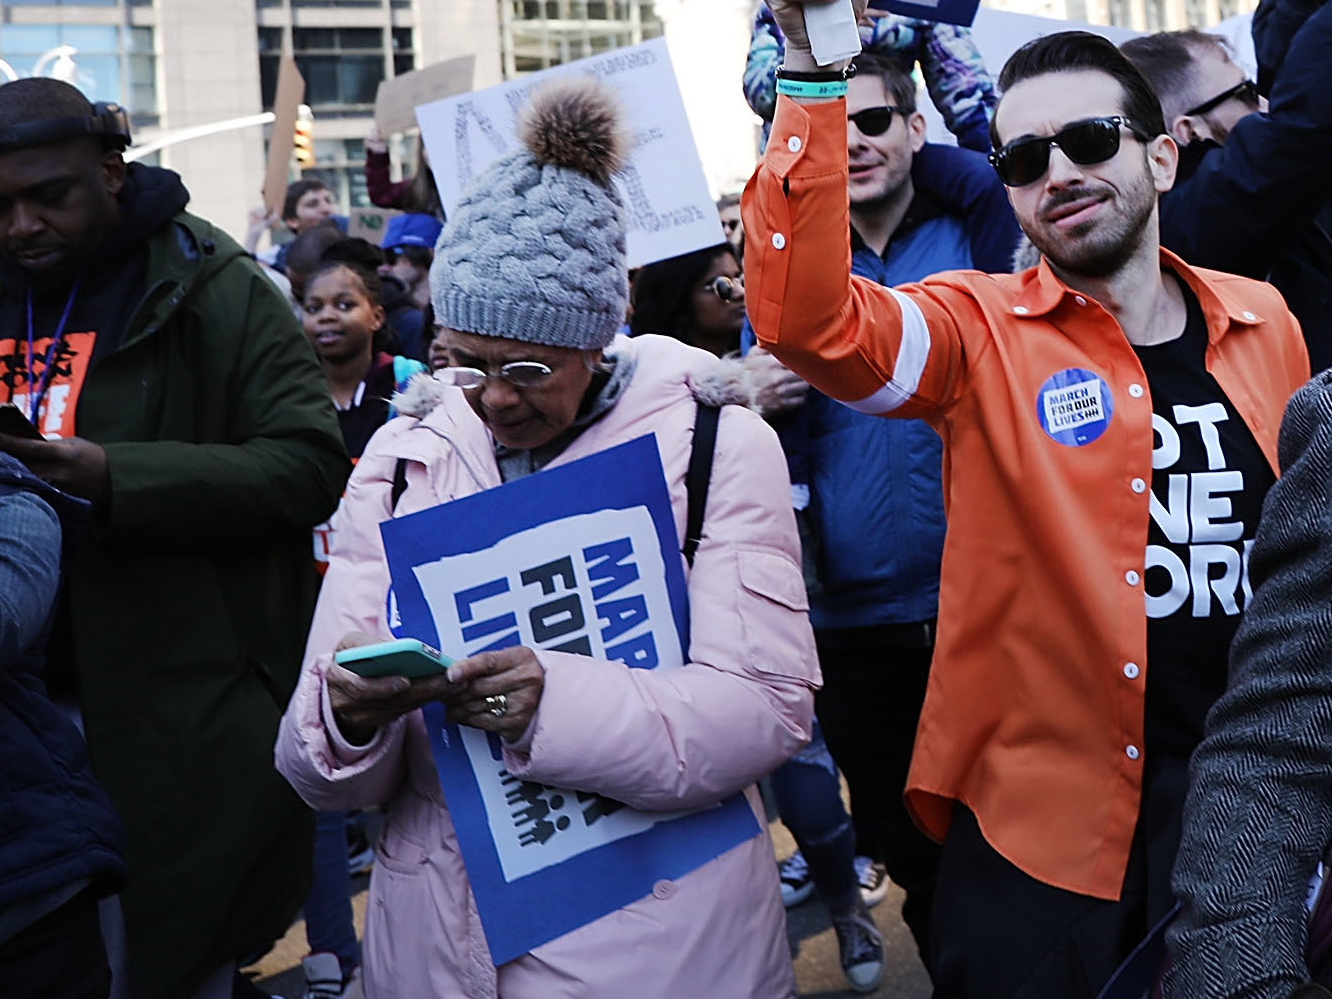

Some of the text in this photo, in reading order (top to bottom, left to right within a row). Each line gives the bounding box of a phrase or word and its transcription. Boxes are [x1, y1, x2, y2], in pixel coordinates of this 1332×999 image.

[1049, 387, 1089, 405] MARCH
[1051, 396, 1097, 416] FOR OUR
[1053, 412, 1085, 427] LIVES
